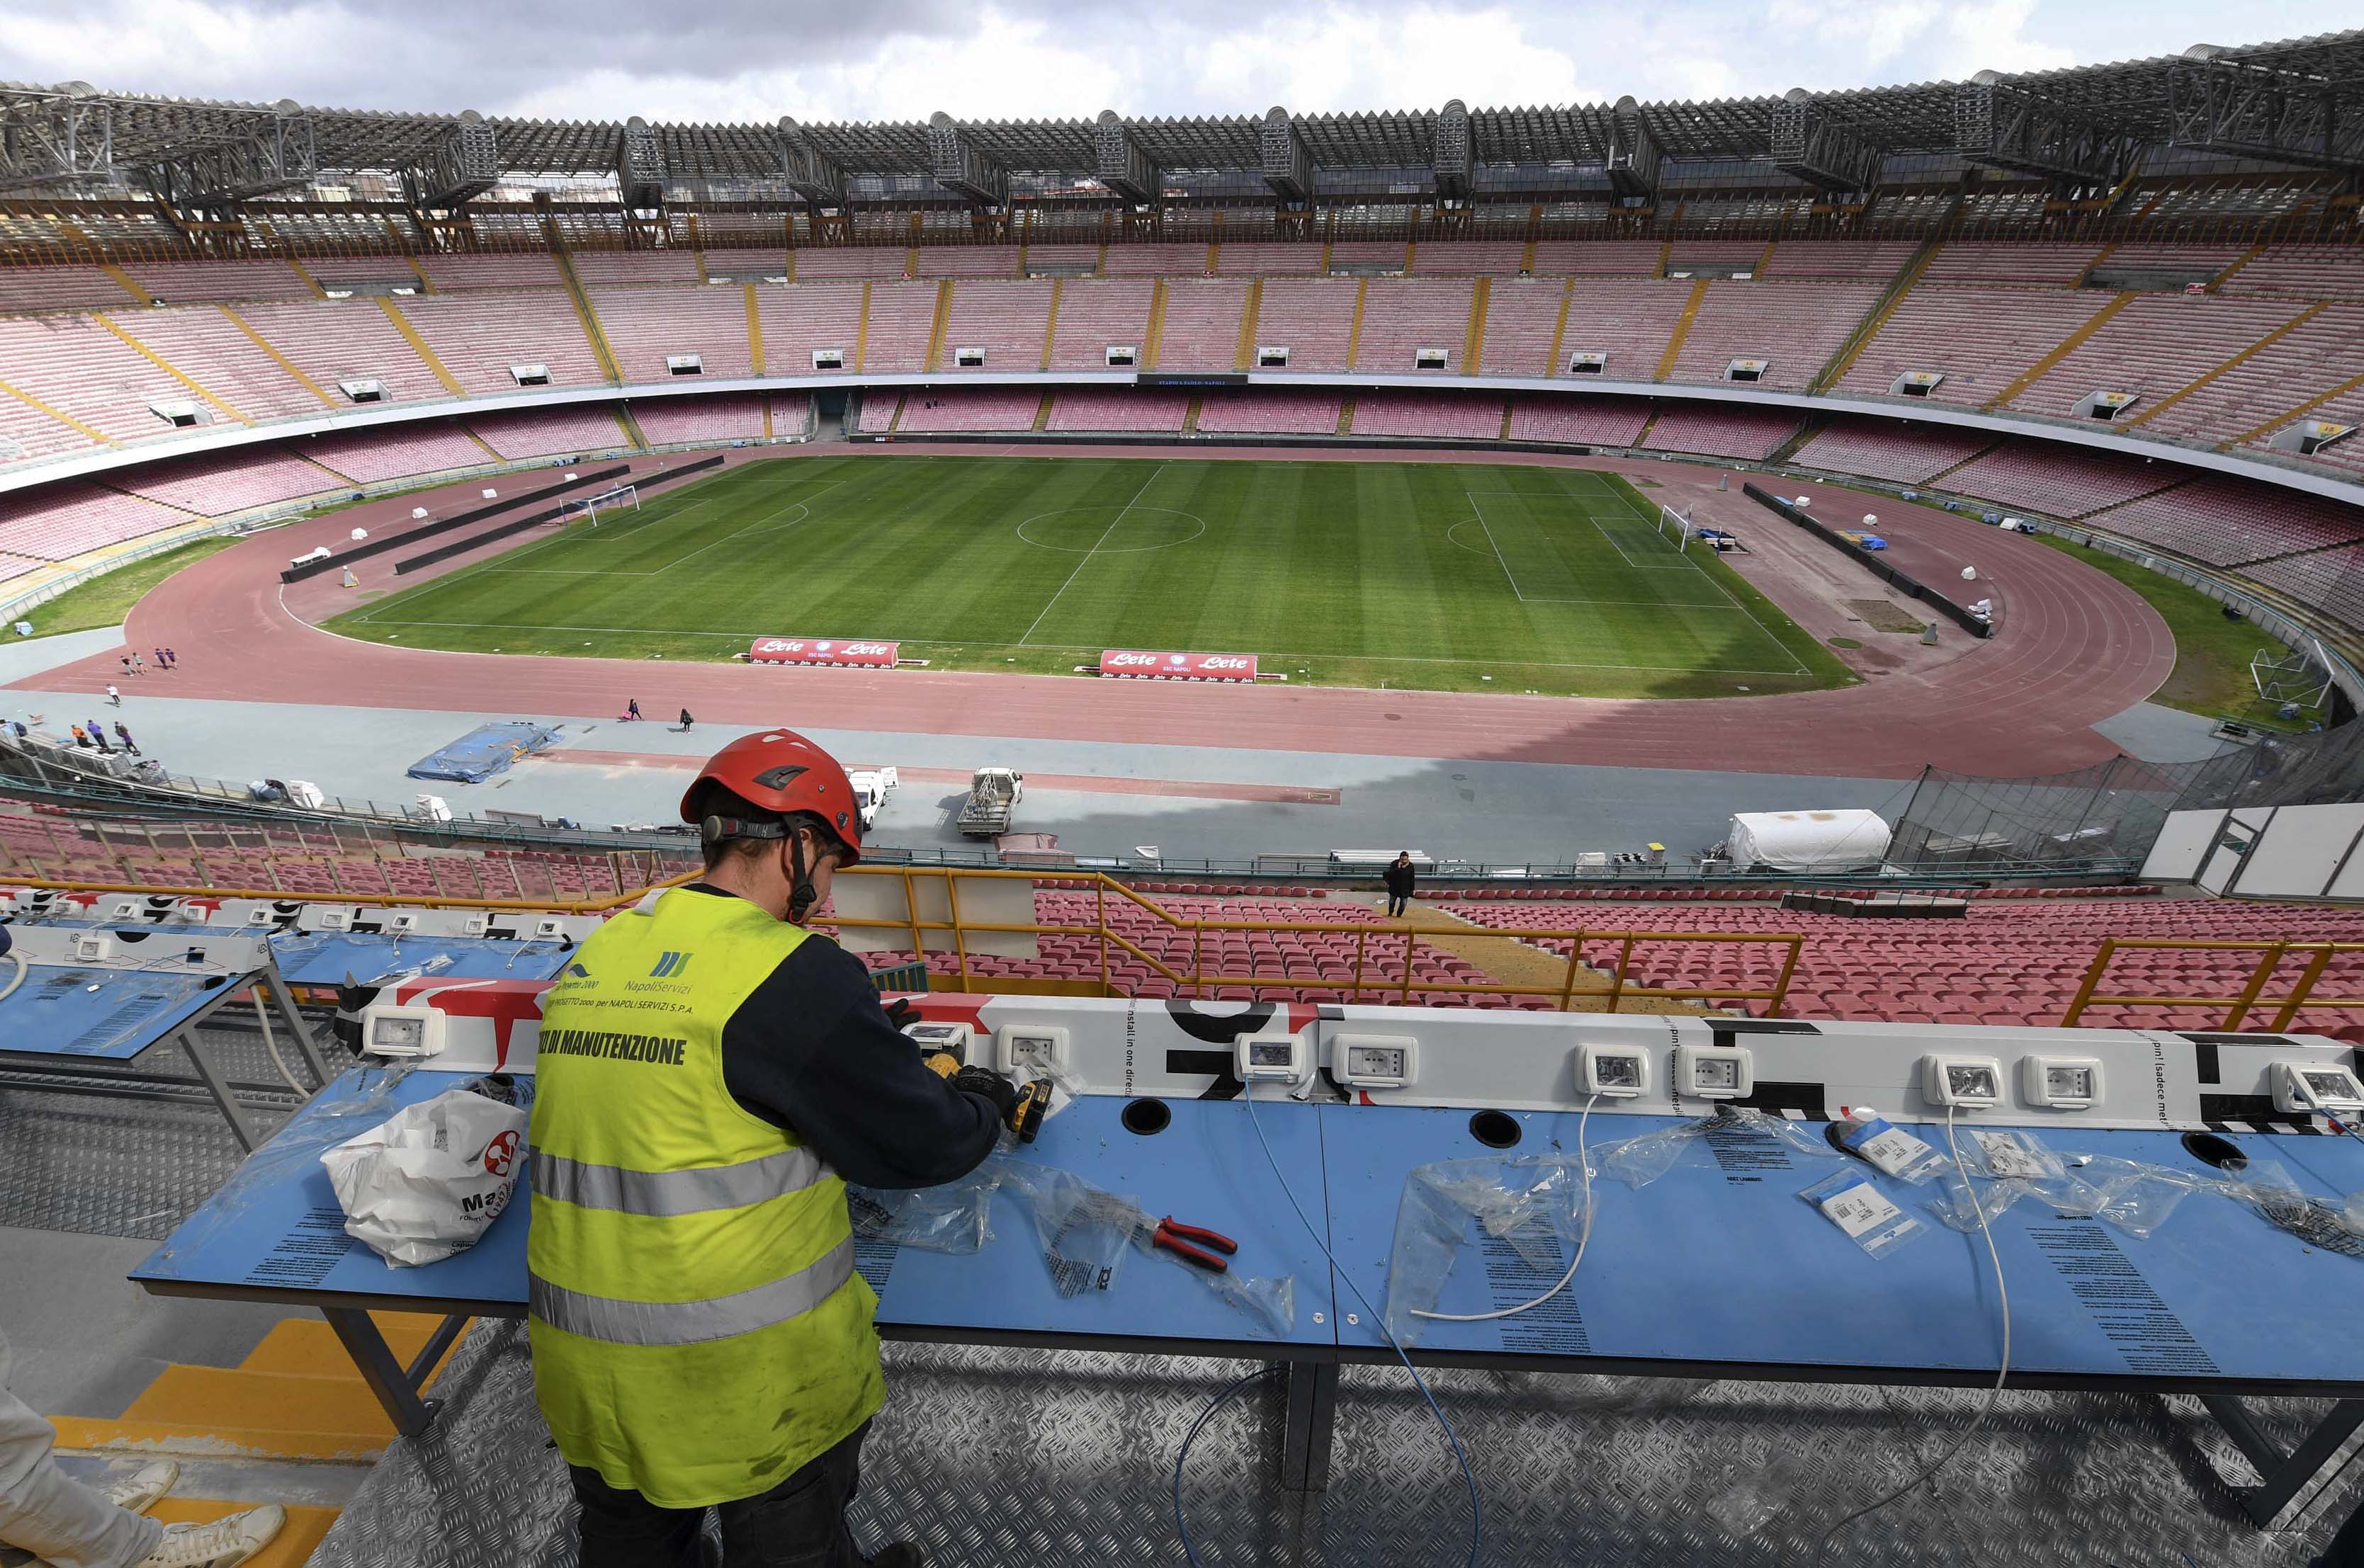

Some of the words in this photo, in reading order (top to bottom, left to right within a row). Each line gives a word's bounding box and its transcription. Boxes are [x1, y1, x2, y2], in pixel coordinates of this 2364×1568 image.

[758, 640, 804, 652] Lete
[840, 643, 888, 655] Lete
[1107, 653, 1157, 666] Lete
[1198, 657, 1248, 669] Lete
[625, 980, 693, 995] NapoliServizi
[596, 1000, 609, 1009] per
[609, 999, 637, 1009] NAPOLI
[638, 1001, 669, 1011] SERVIZI
[669, 1004, 694, 1015] S.P.A.
[547, 1030, 562, 1054] DI
[559, 1030, 687, 1066] MANUTENZIONE
[1126, 1038, 1136, 1047] in
[462, 1193, 496, 1212] Ma
[492, 1191, 507, 1213] 1947
